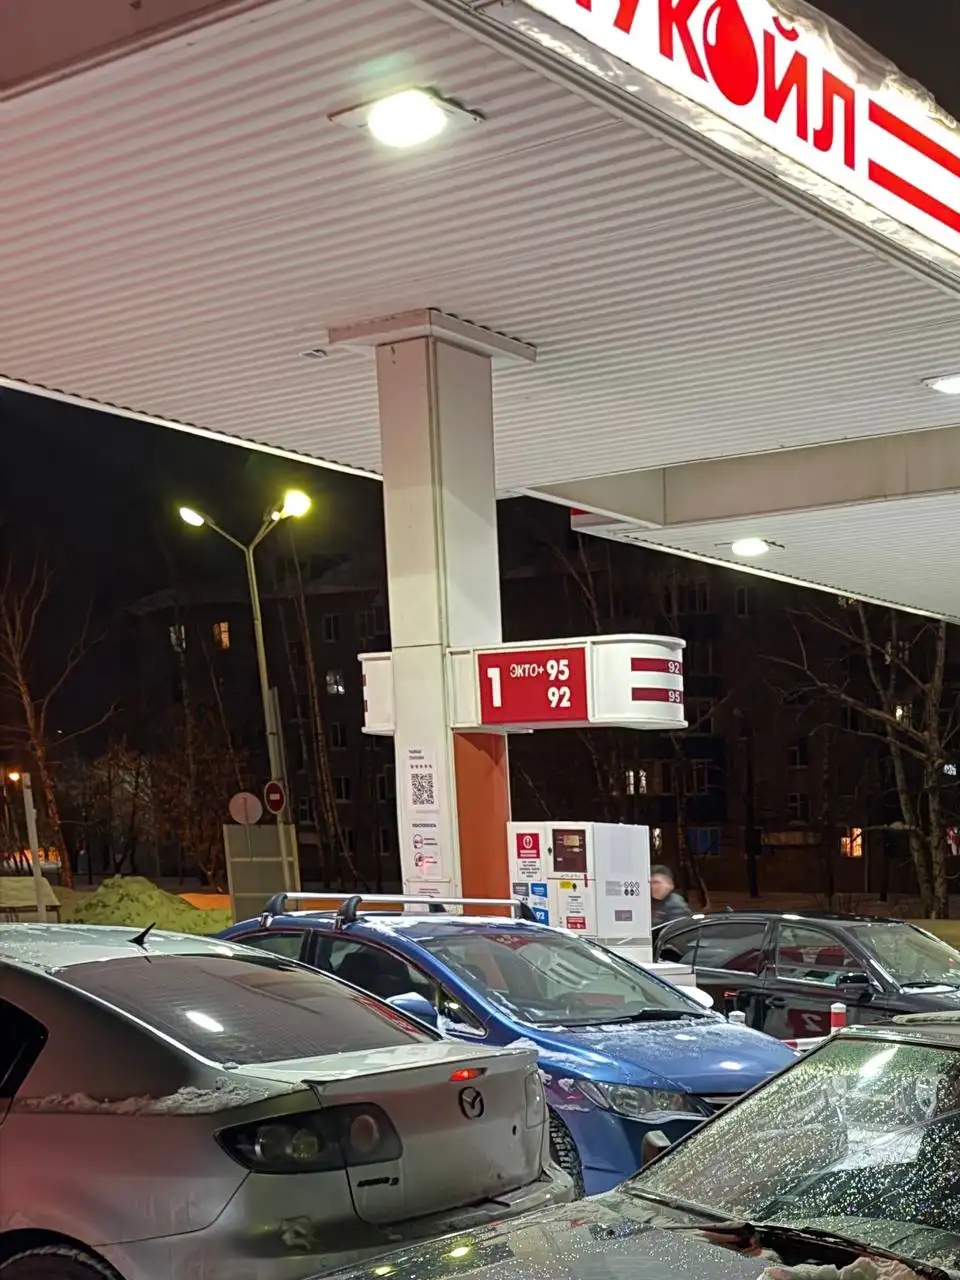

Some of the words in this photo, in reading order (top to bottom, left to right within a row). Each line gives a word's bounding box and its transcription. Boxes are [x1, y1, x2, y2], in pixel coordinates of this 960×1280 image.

[575, 0, 856, 171] КОЙЛ
[510, 663, 545, 678] ЭКТО+
[546, 659, 570, 681] 95
[668, 661, 681, 674] 92
[487, 667, 502, 707] 1
[547, 686, 571, 708] 92
[668, 690, 681, 703] 95
